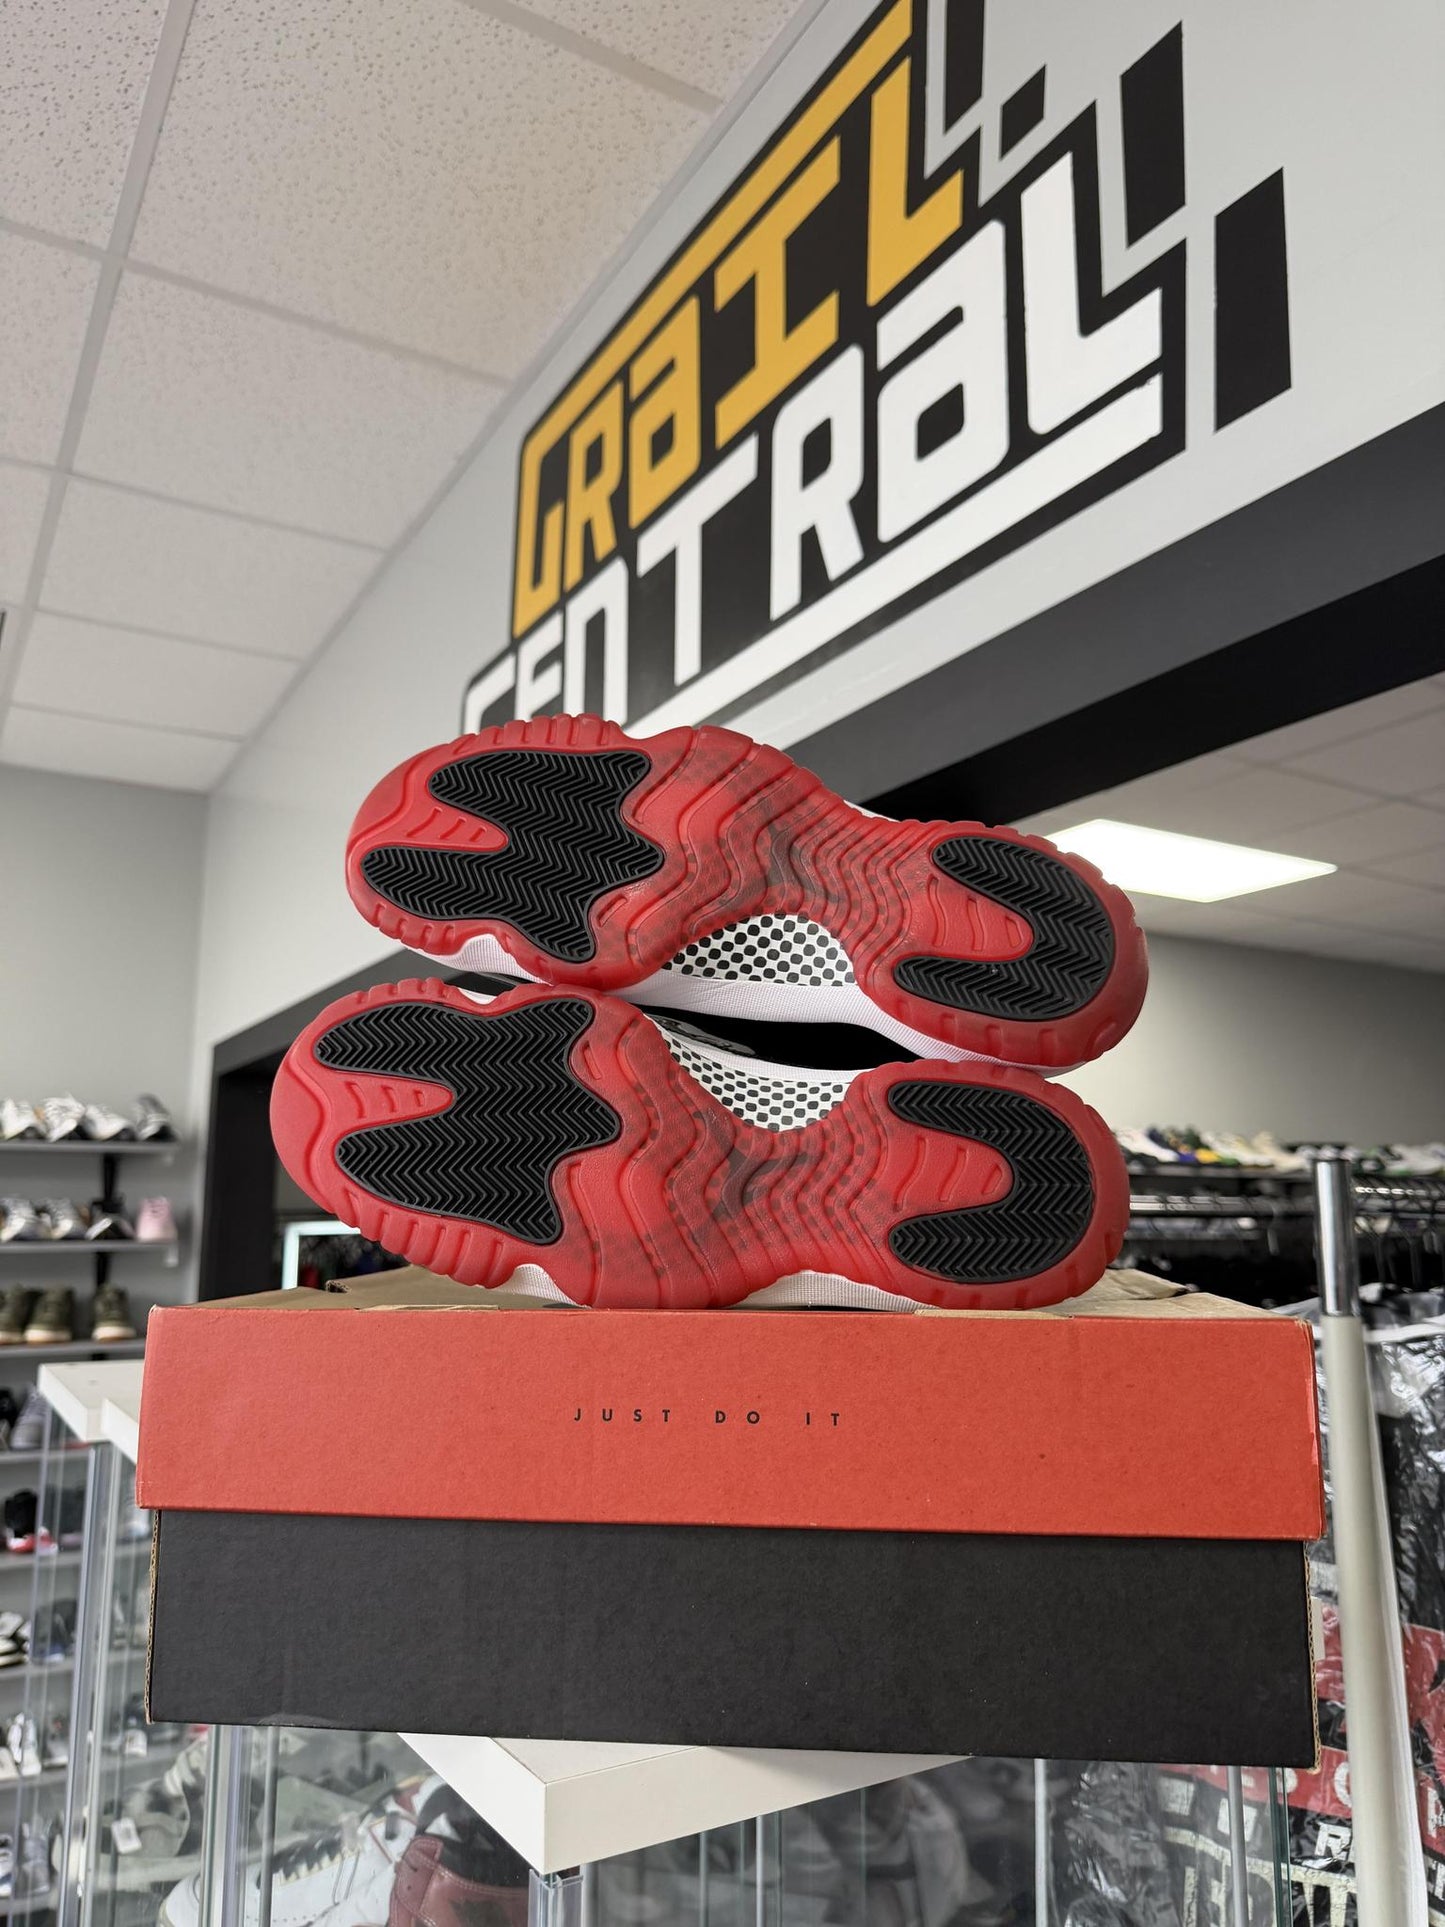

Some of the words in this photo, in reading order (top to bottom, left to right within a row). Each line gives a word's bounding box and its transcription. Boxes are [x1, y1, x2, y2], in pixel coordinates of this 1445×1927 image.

[574, 1408, 671, 1422] JUST
[715, 1410, 760, 1424] DO
[805, 1412, 840, 1426] IT
